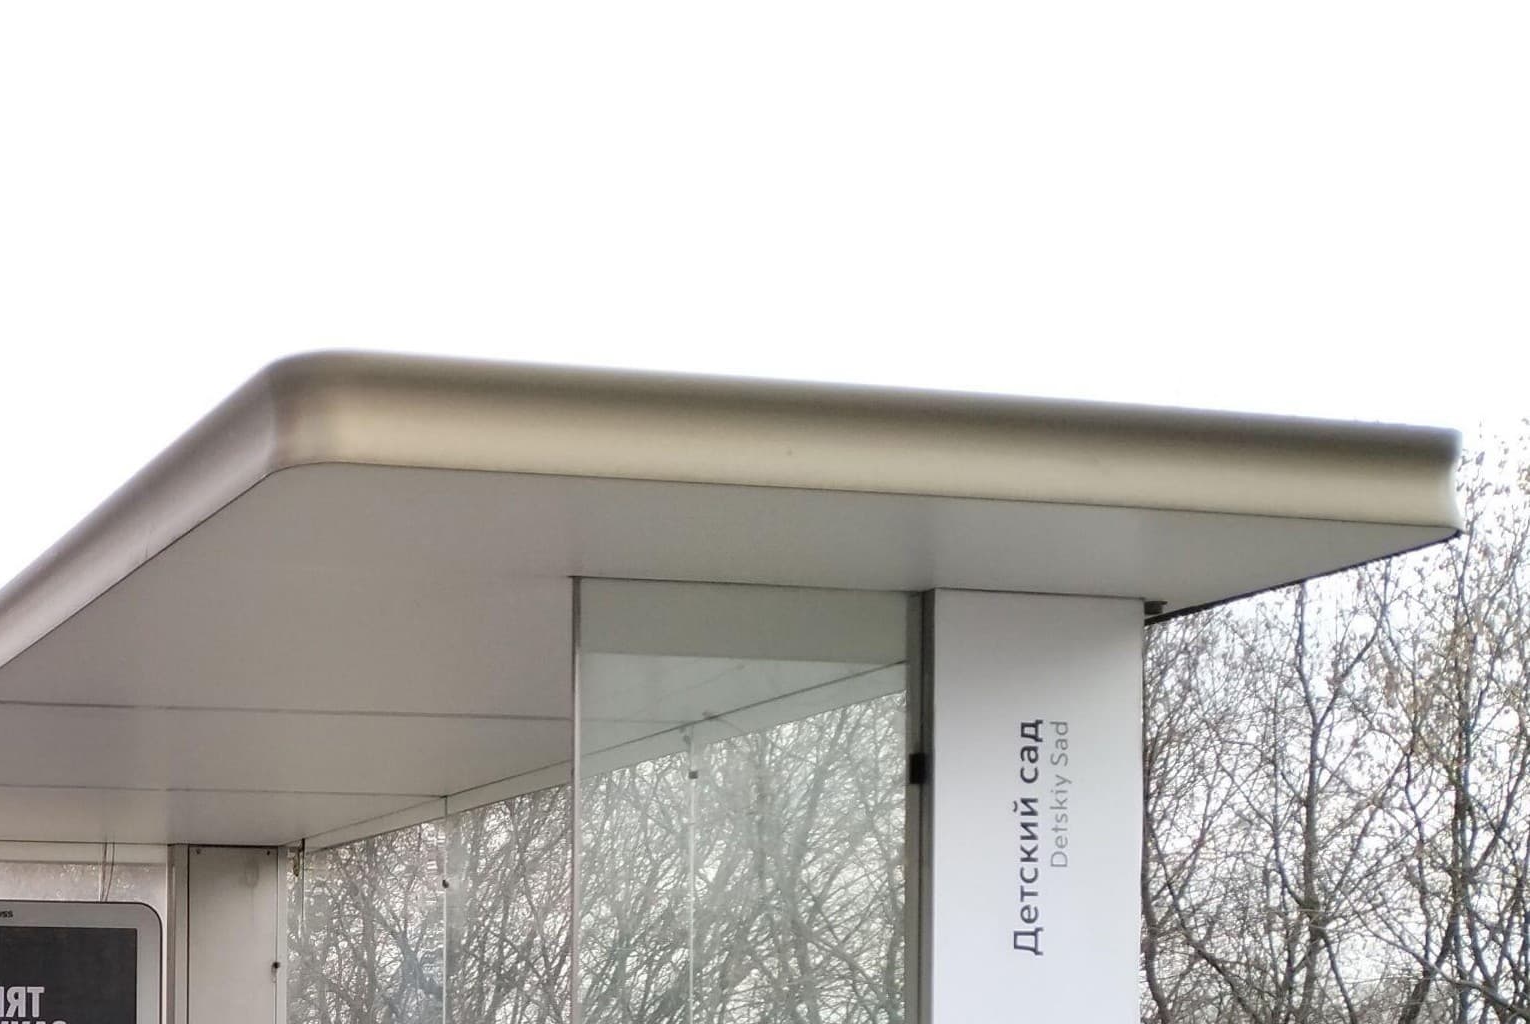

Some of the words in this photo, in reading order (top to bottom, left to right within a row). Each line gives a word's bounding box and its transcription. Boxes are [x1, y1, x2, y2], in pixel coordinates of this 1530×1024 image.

[1019, 719, 1044, 784] сад
[1050, 720, 1069, 767] Sad
[1050, 774, 1072, 868] Detskiy
[1013, 798, 1044, 956] Детский
